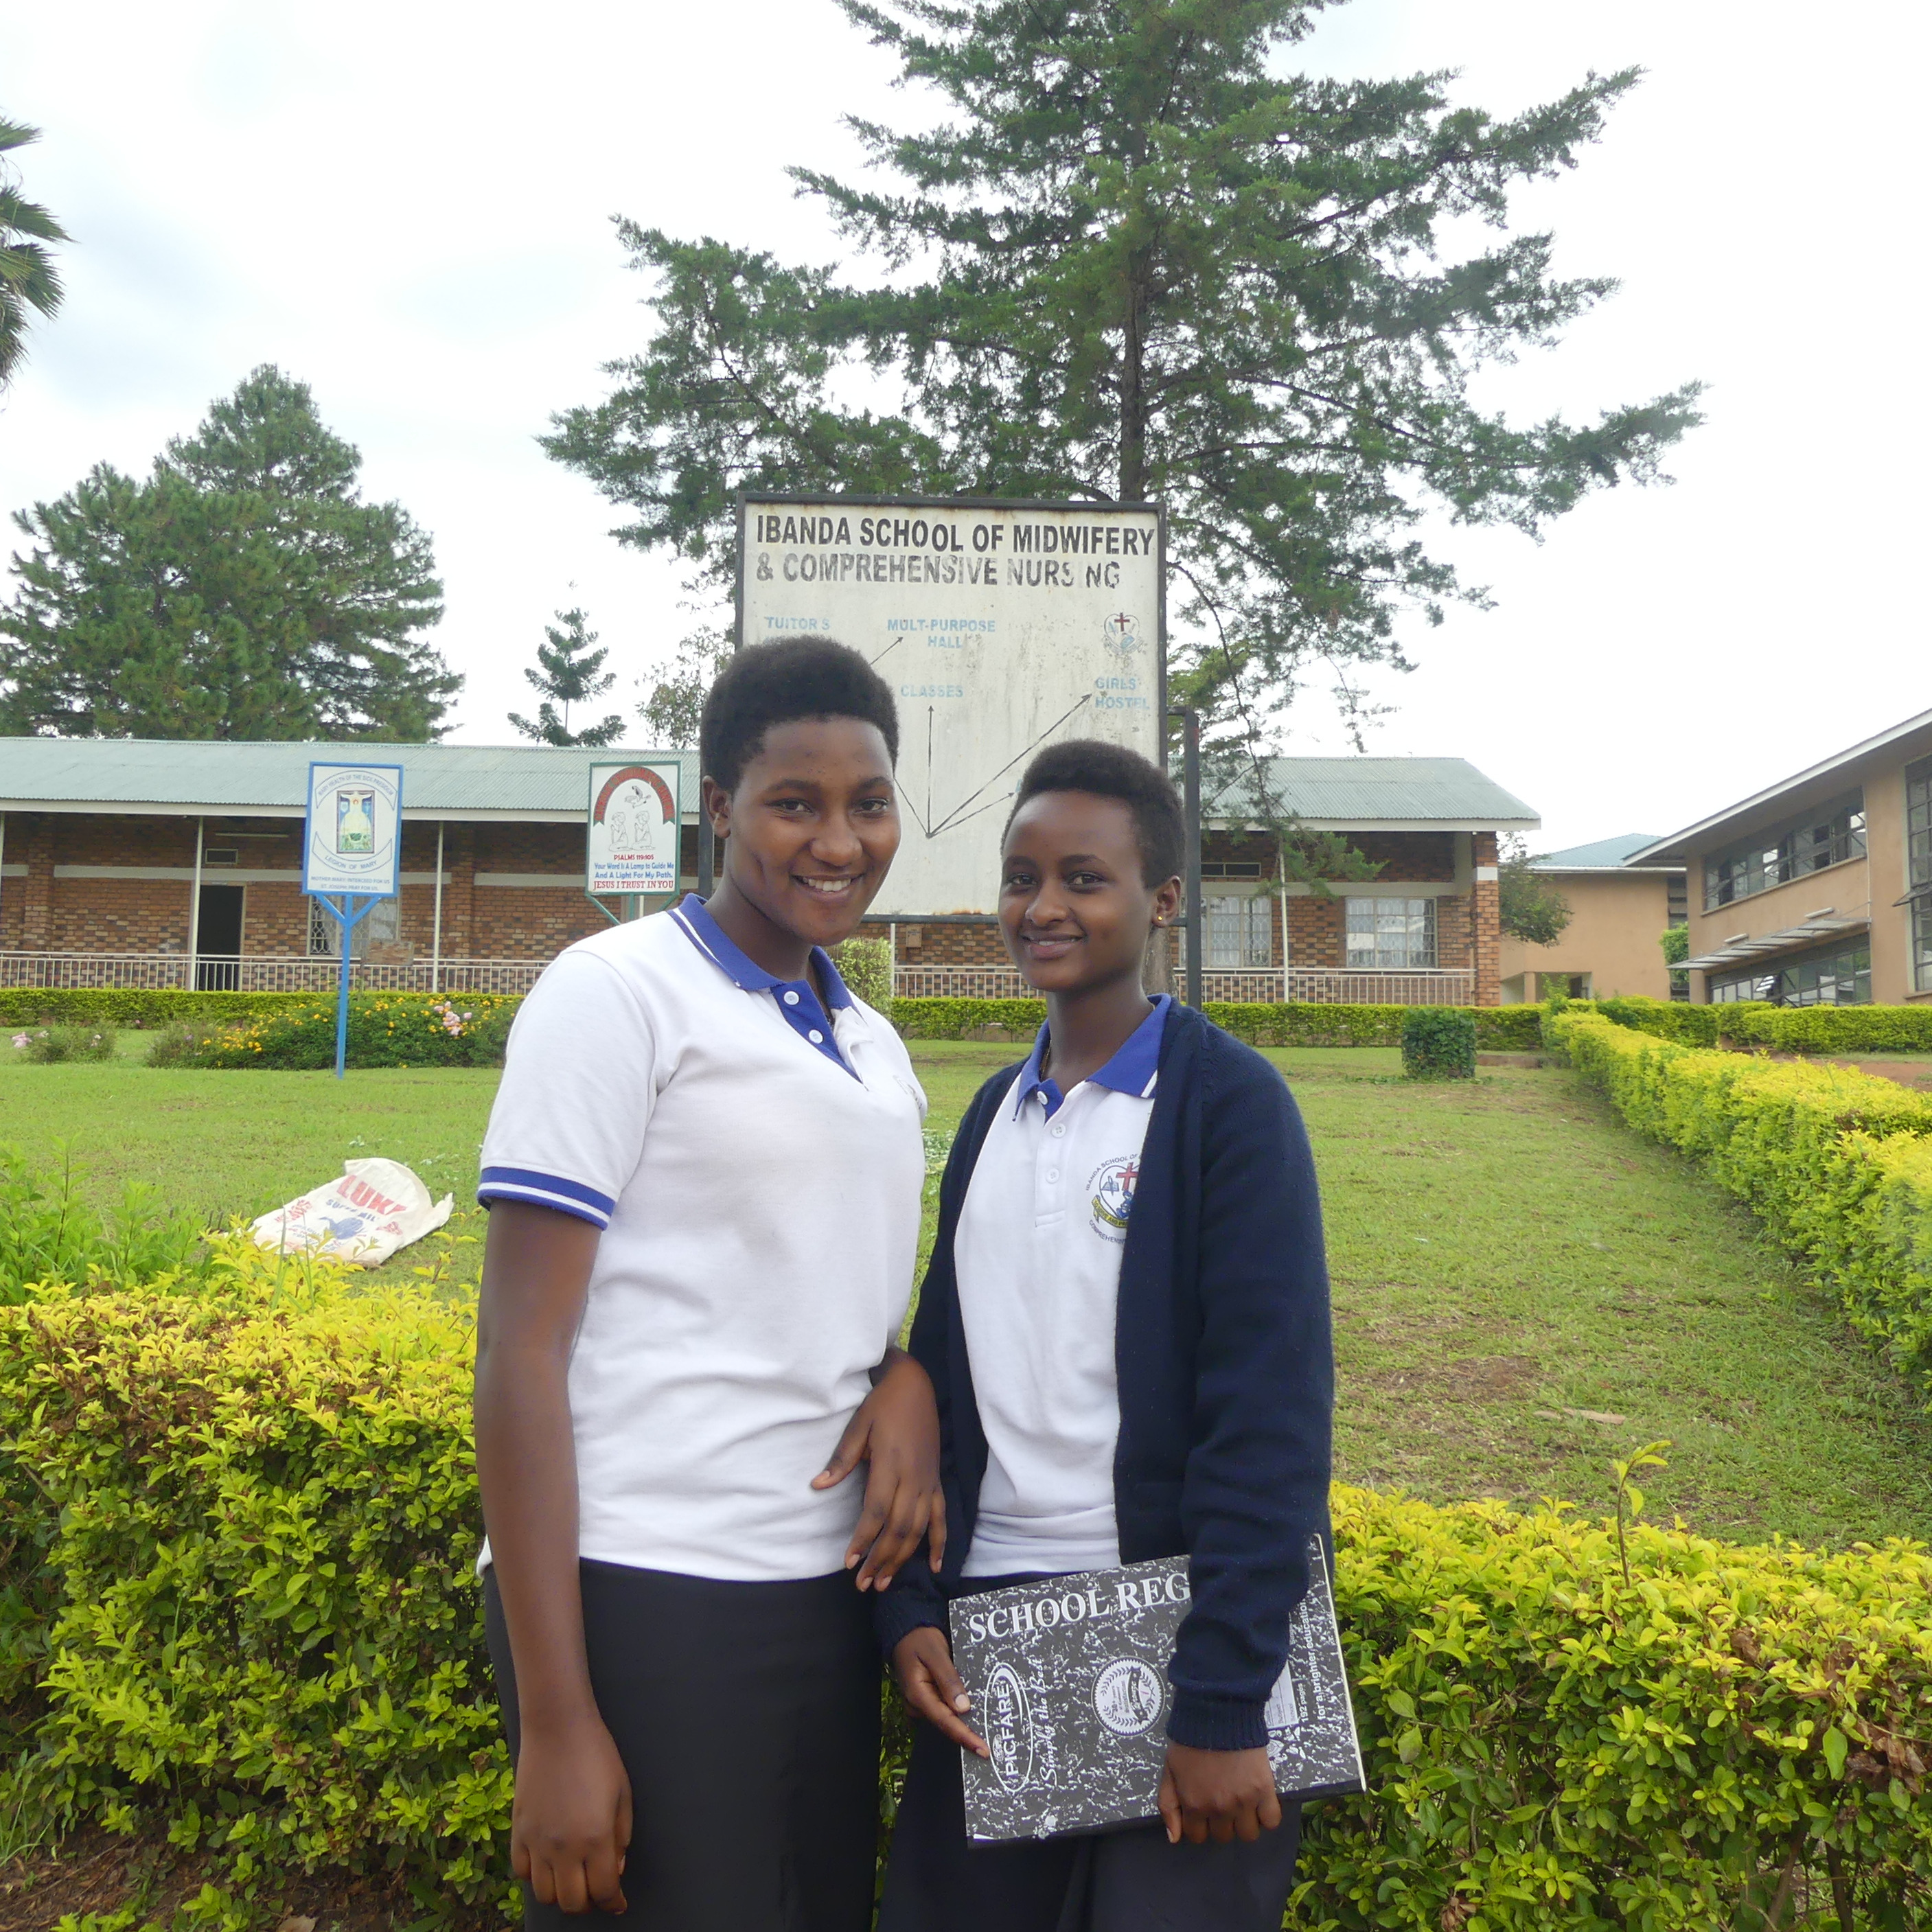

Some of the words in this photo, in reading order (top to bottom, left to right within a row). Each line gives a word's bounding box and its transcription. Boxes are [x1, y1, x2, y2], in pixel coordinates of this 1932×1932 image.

[757, 515, 851, 545] IBANDA
[860, 518, 964, 552] SCHOOL
[972, 524, 1004, 552] OF
[1013, 525, 1155, 555] MIDWIFERY
[756, 552, 774, 582] &
[783, 553, 998, 585] COMPREHENSIVE
[887, 619, 996, 632] MULT-PURPOSE
[928, 636, 963, 649] HALL
[901, 685, 963, 698] CLASSES
[1095, 676, 1136, 690] GIRLS
[1095, 696, 1150, 709] HOSTEL
[325, 855, 346, 869] LEGION
[360, 860, 377, 869] MARY
[616, 871, 632, 879] Light
[645, 871, 654, 879] My
[593, 881, 614, 890] JESUS
[621, 880, 645, 888] TRUST
[647, 880, 657, 888] IN
[657, 880, 674, 888] YOU
[1085, 1167, 1101, 1191] IBANDA
[1101, 1156, 1128, 1168] SCHOOL
[969, 1588, 1111, 1644] SCHOOL
[1029, 1655, 1046, 1694] Best
[1308, 1651, 1322, 1694] brighter
[1297, 1683, 1308, 1705] pages
[1316, 1693, 1323, 1702] a
[1031, 1698, 1049, 1721] the
[1299, 1705, 1309, 1723] 192
[1316, 1702, 1326, 1721] for
[996, 1683, 1019, 1778] PICFARE
[1035, 1723, 1058, 1788] Simply
